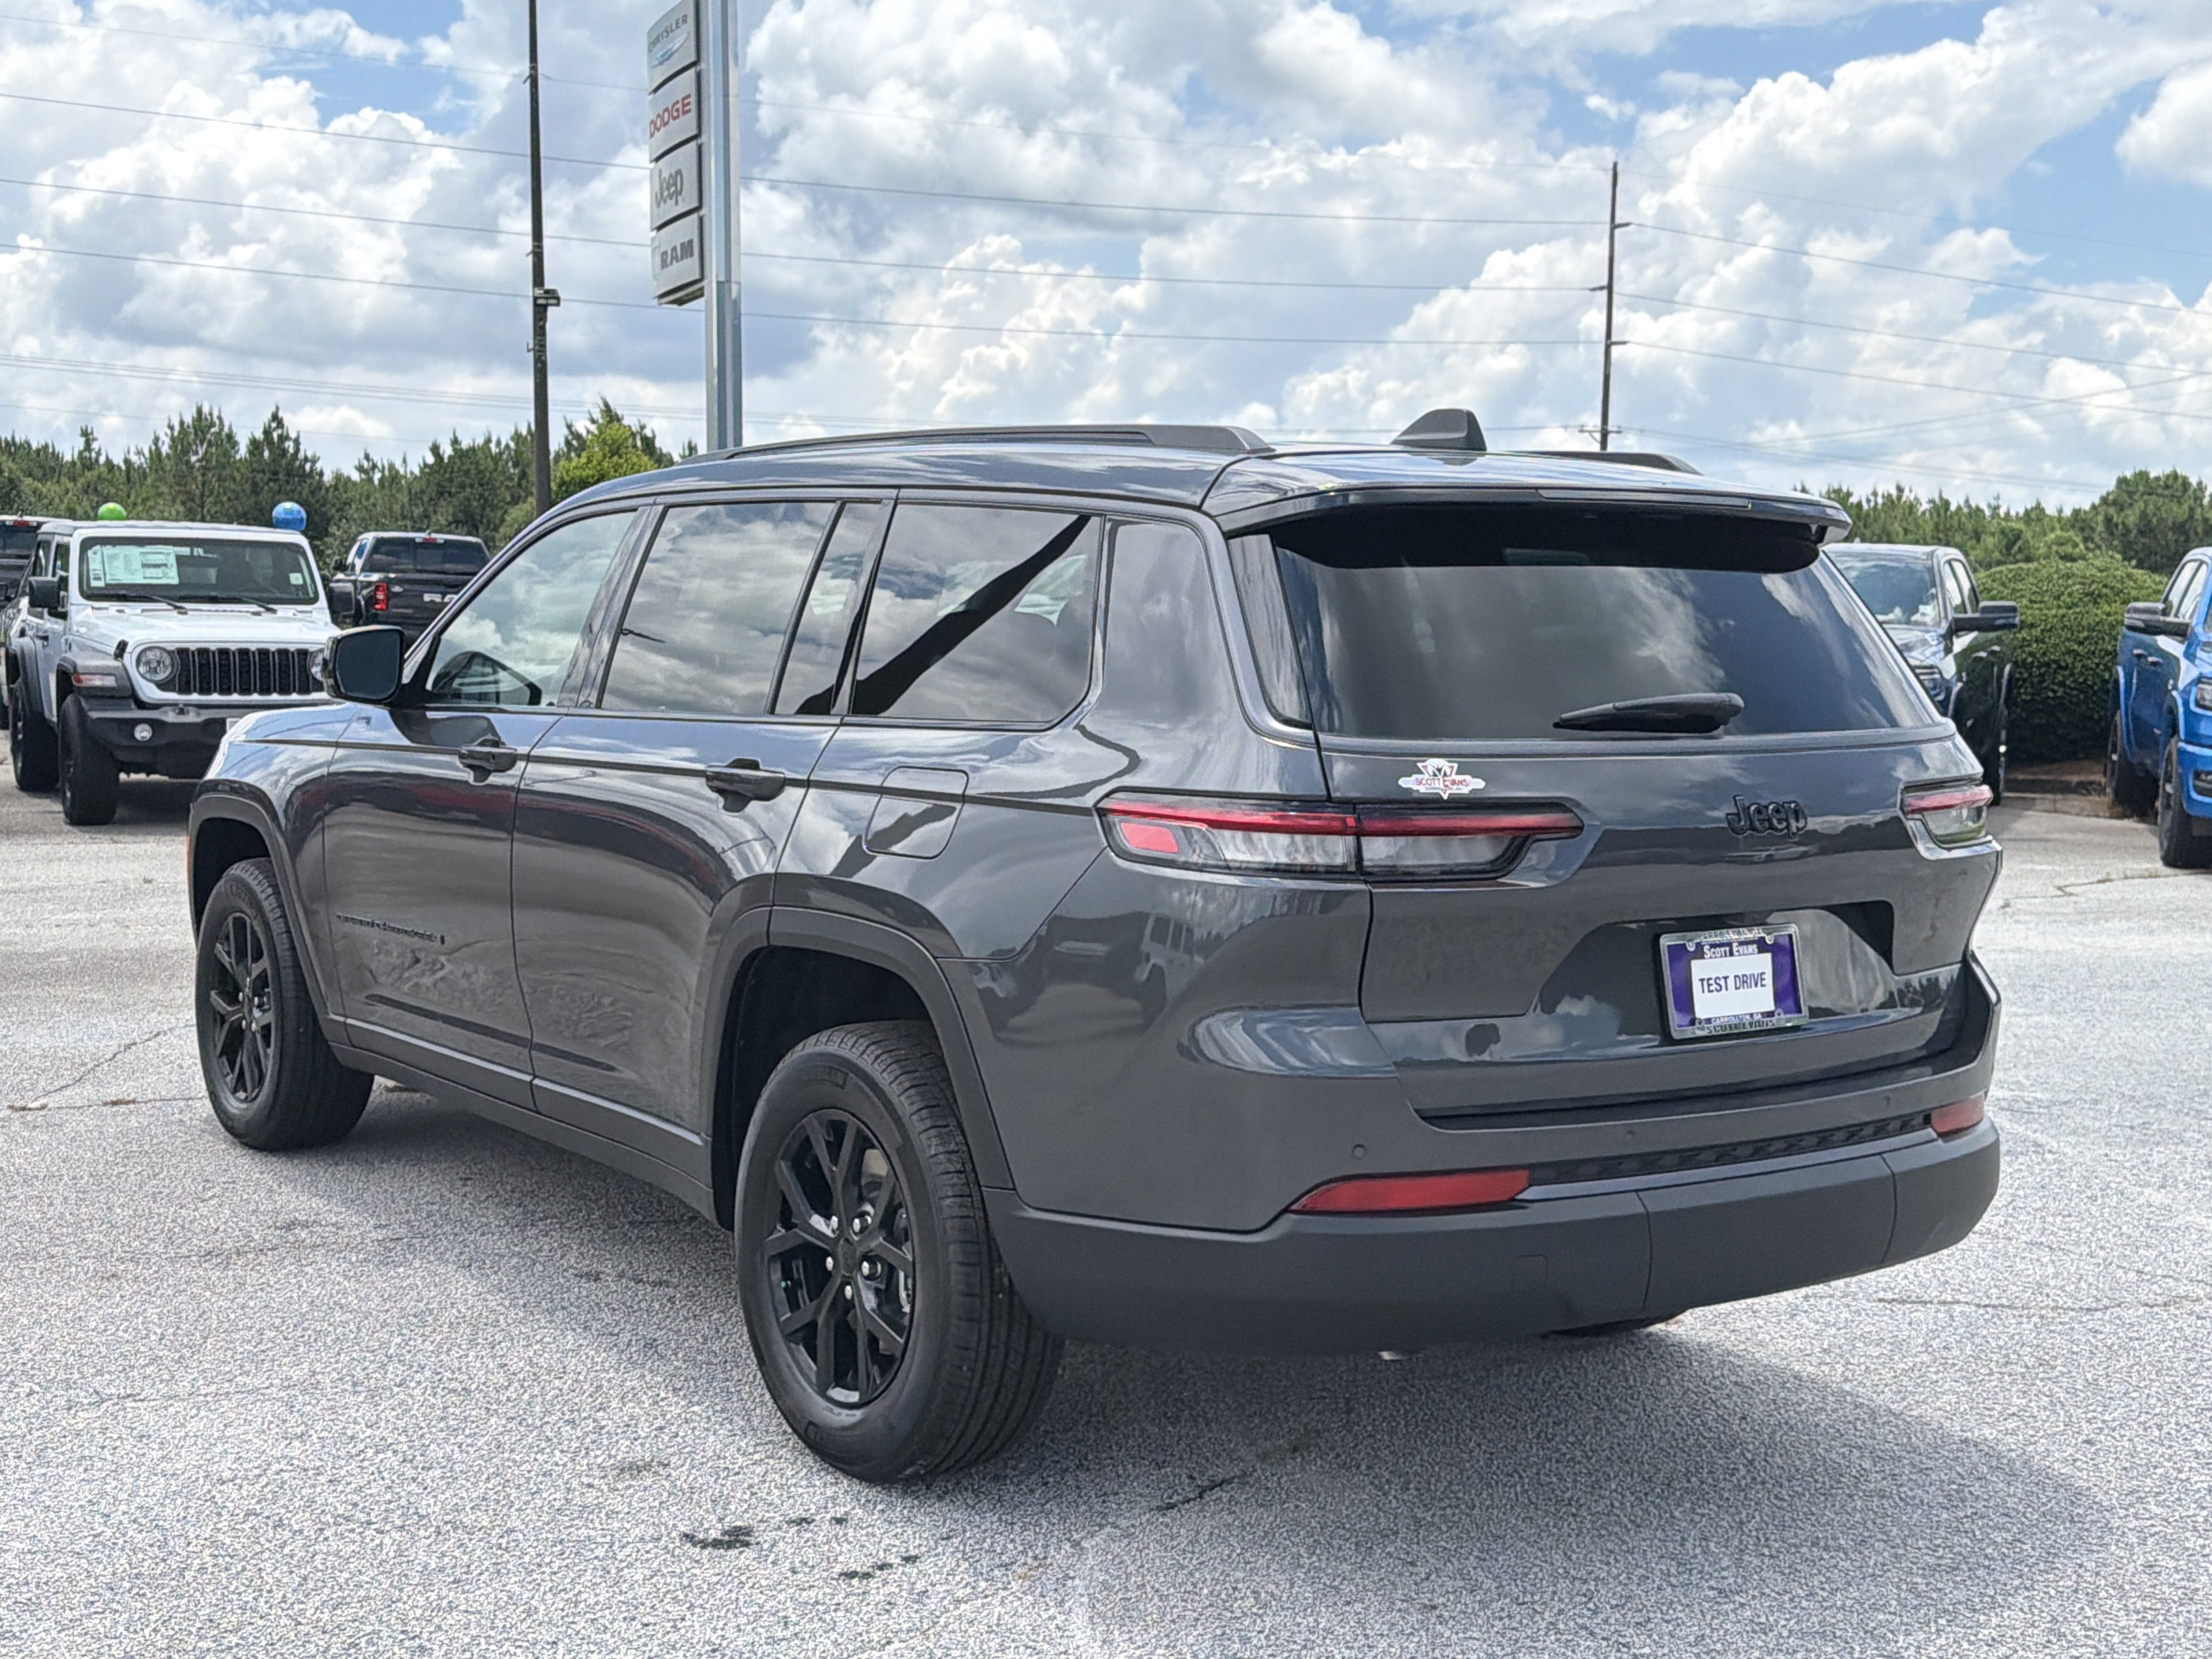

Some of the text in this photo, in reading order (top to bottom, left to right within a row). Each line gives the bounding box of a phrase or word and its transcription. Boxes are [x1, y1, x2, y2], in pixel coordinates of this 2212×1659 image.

[650, 93, 691, 139] DODGE
[655, 168, 683, 208] Jeep
[661, 238, 694, 270] RAM
[423, 593, 458, 602] RA
[1415, 776, 1469, 788] SCOTT EVANS
[1725, 794, 1808, 840] Jeep
[1698, 972, 1766, 994] TEST DRIVE
